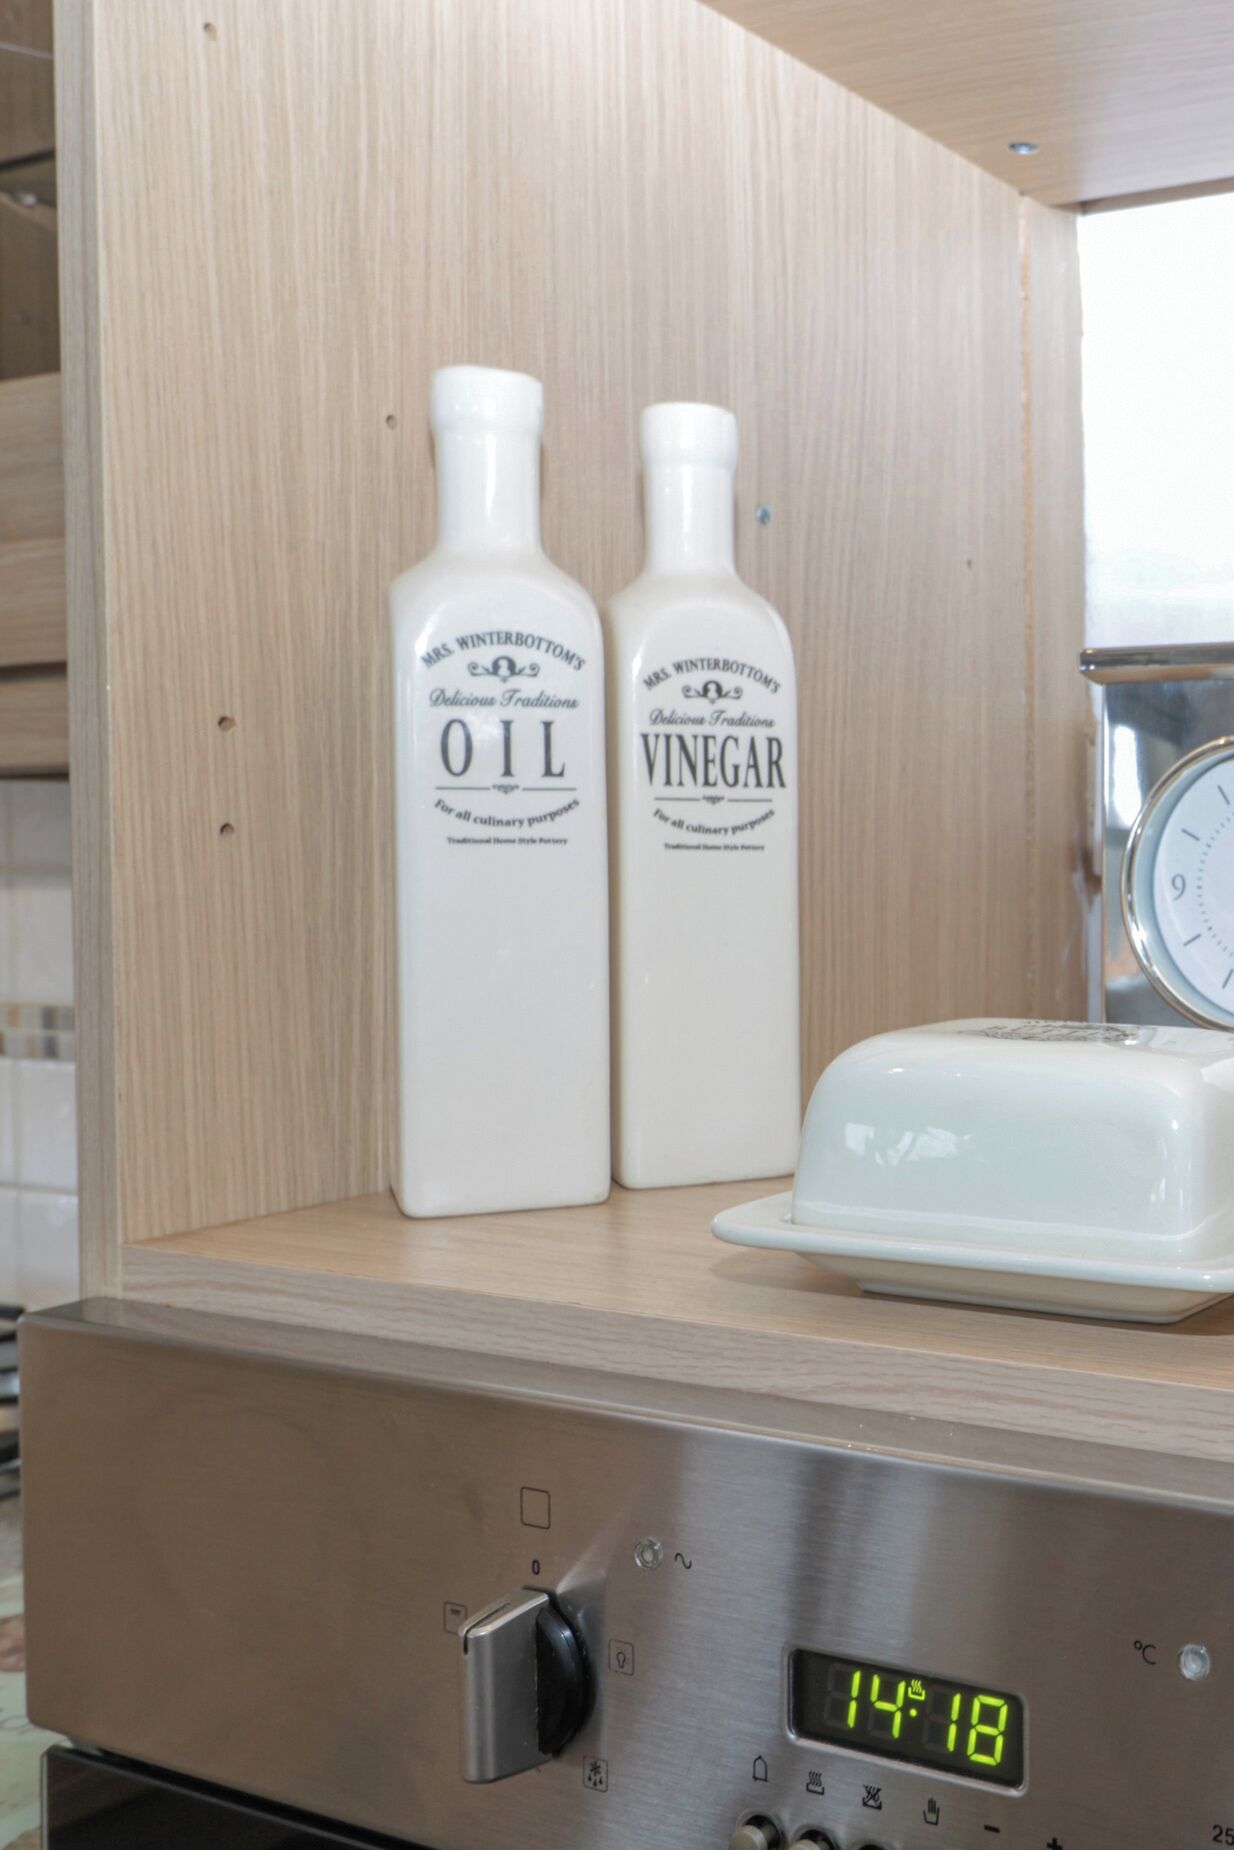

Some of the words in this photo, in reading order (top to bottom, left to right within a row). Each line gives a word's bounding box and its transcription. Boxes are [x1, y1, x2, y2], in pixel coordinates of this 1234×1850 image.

[421, 642, 455, 669] MRS.
[455, 630, 586, 671] WINTERBOTTOM'S
[643, 667, 672, 691] MRS.
[672, 657, 781, 695] WINTERBOTTOM'S
[429, 687, 497, 708] Delicious
[500, 688, 580, 709] Traditions
[649, 708, 706, 727] Delicious
[708, 709, 775, 728] Traditions
[440, 718, 566, 778] OIL
[640, 732, 787, 789] VINEGAR
[434, 798, 454, 816] For
[455, 809, 472, 822] all
[472, 814, 526, 829] culinary
[527, 798, 580, 828] purposes
[653, 808, 671, 824] For
[671, 817, 685, 830] all
[685, 822, 729, 837] culinary
[730, 808, 775, 836] purposes
[1171, 873, 1187, 901] 9
